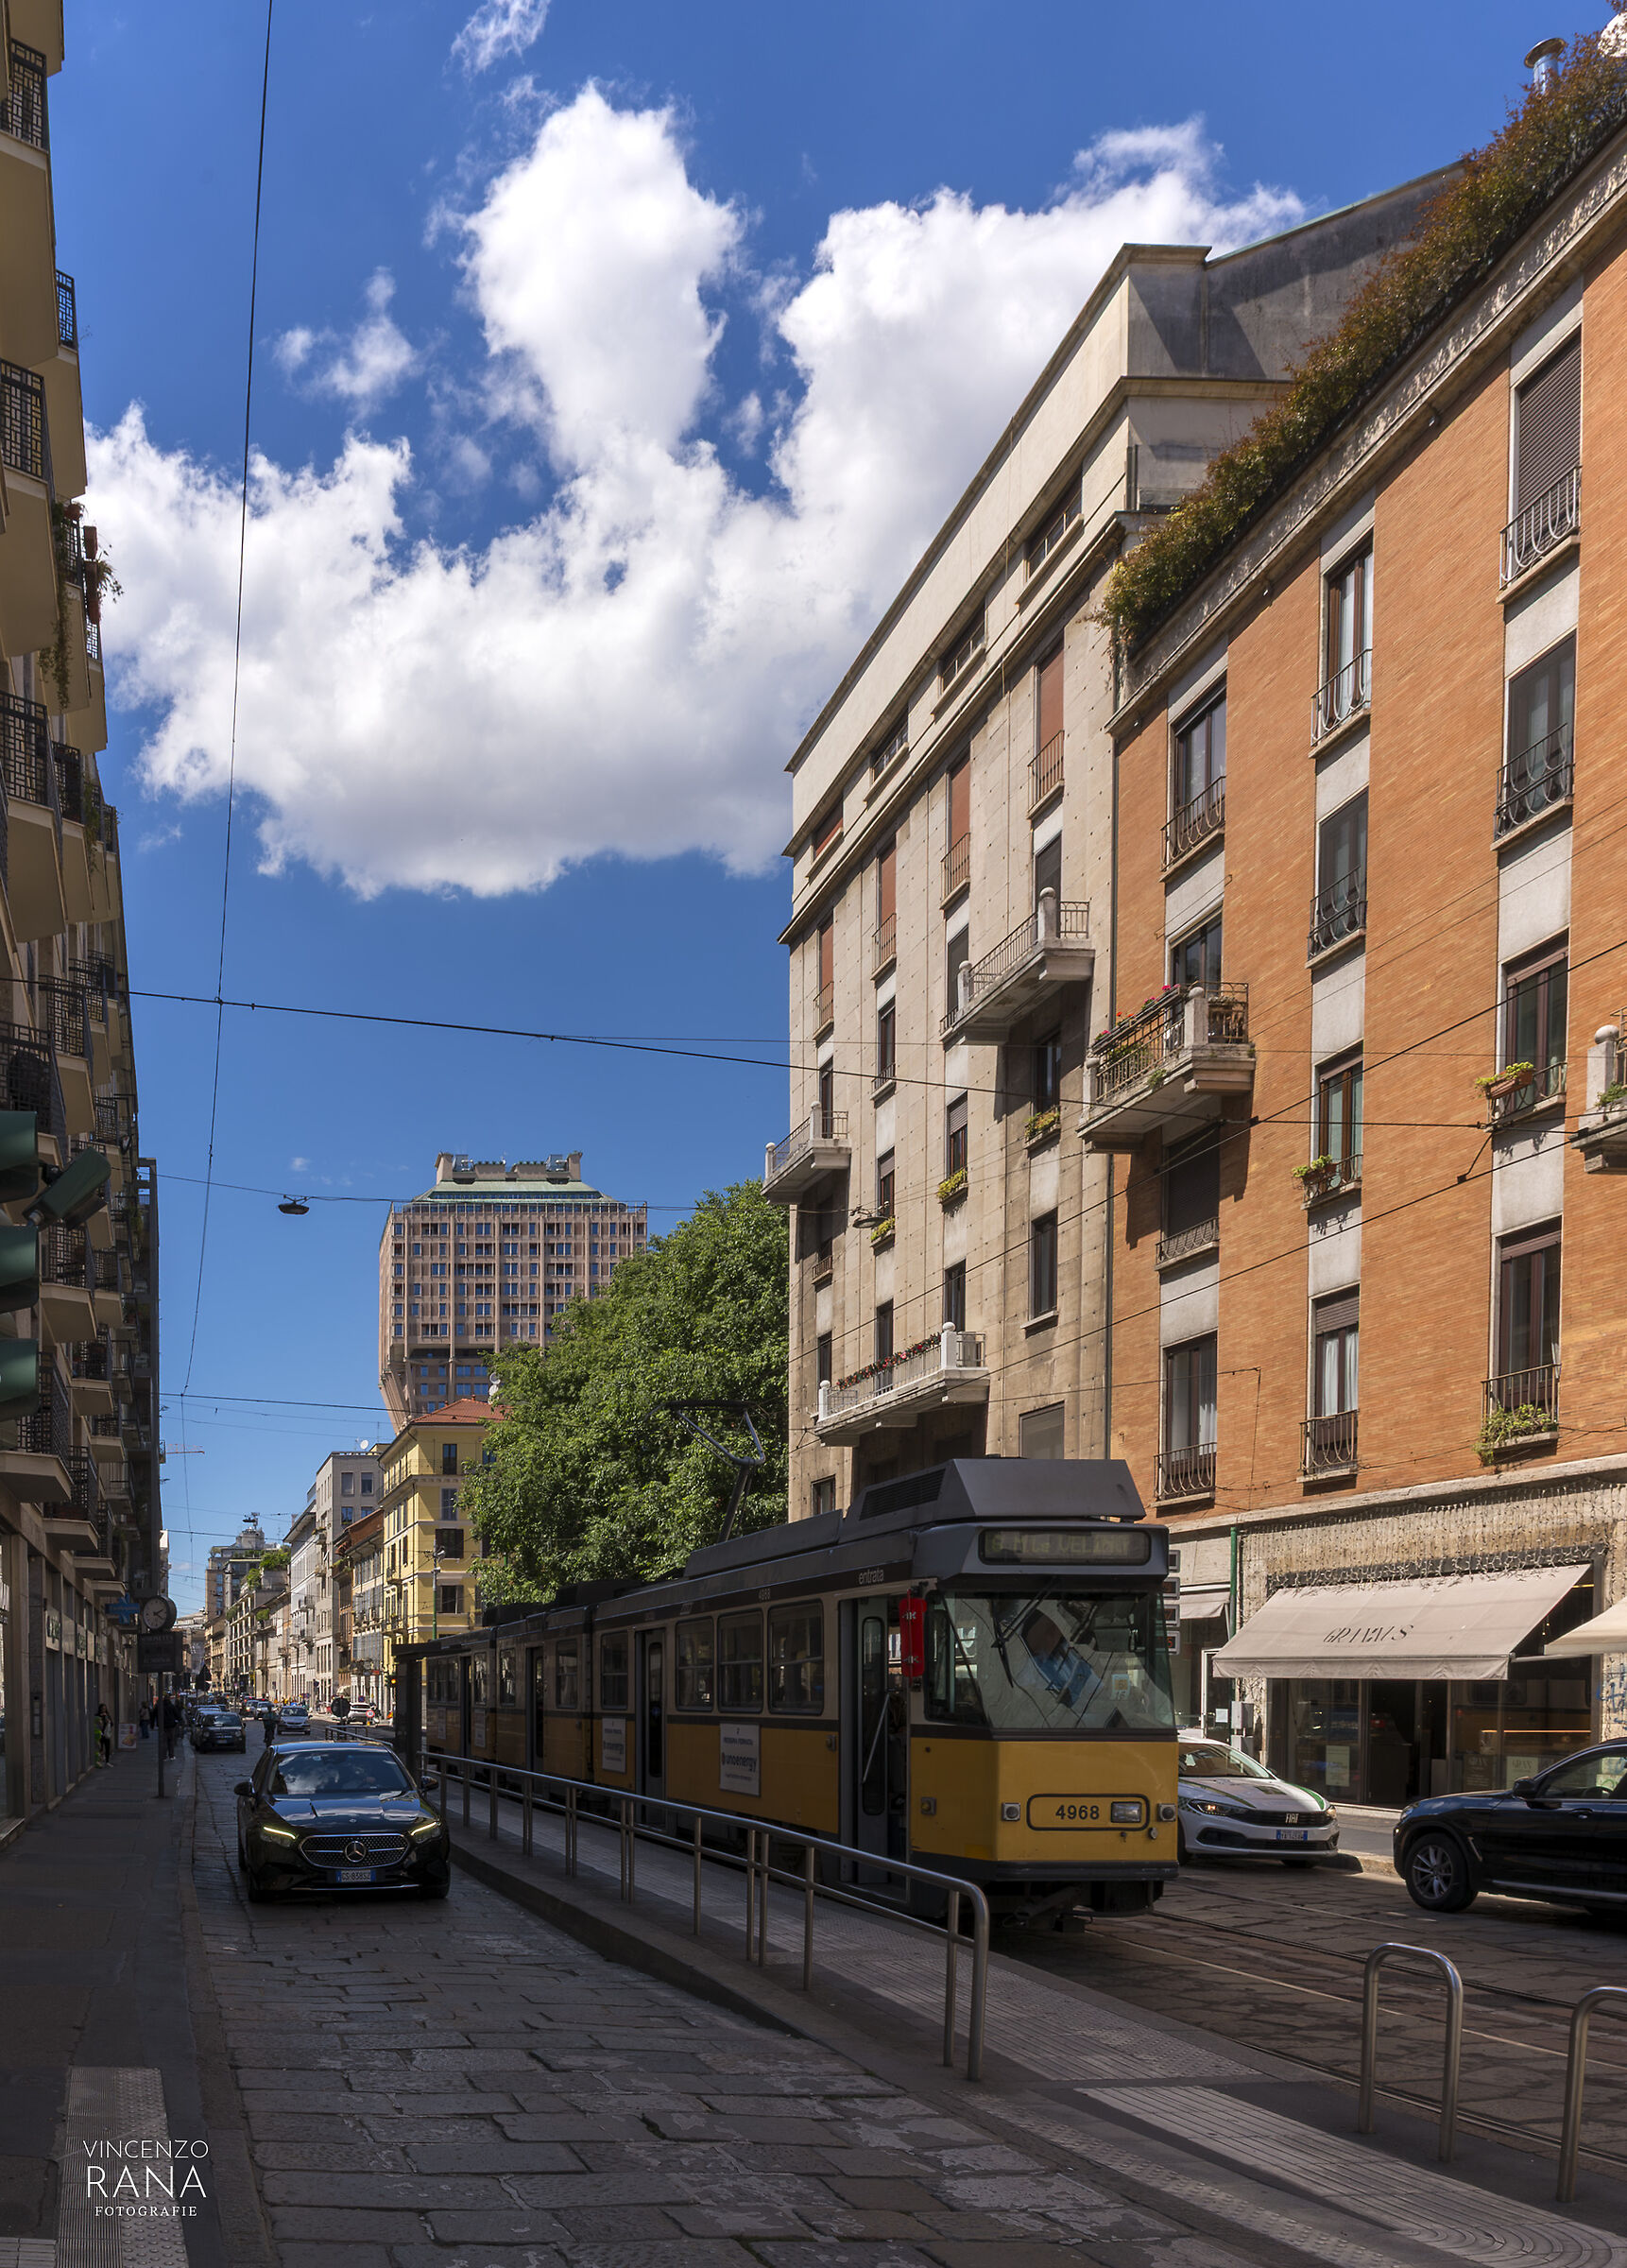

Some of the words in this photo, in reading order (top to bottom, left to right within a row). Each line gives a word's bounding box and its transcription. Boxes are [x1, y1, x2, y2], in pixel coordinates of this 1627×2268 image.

[858, 1567, 884, 1585] entrata
[725, 1754, 758, 1773] unoenergy
[1054, 1804, 1100, 1820] 4968
[1285, 1813, 1300, 1824] FIAT
